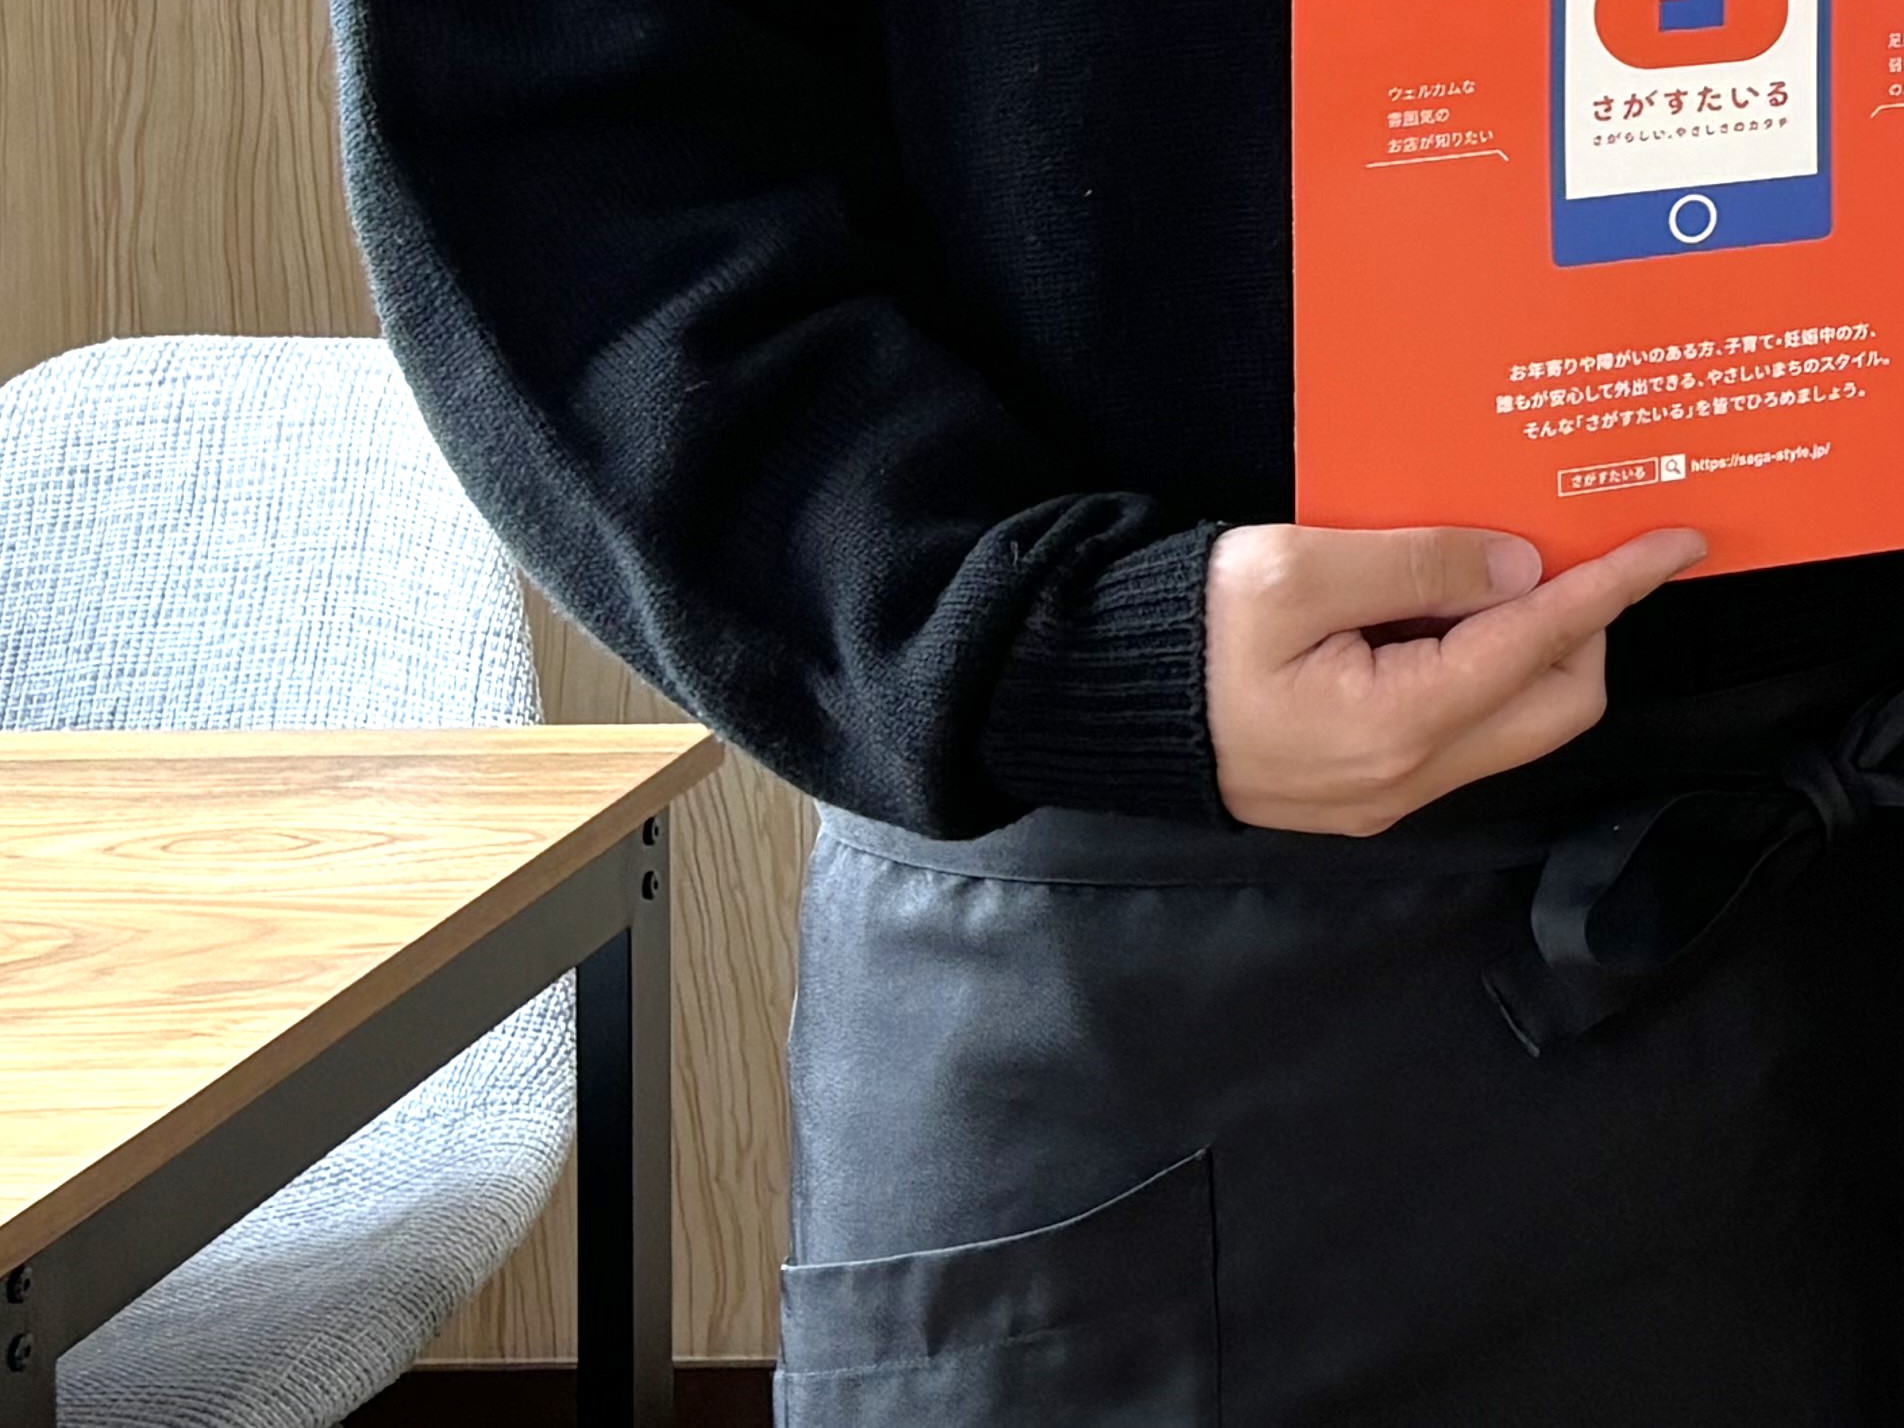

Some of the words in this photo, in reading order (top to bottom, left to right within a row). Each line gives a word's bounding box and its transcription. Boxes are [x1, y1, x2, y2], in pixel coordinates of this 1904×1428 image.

[1388, 80, 1475, 101] ウェルカムな
[1593, 81, 1788, 121] さがすたいる
[1388, 130, 1493, 153] お店が知りたい
[1690, 442, 1831, 474] https://saga-style.jp/
[1570, 466, 1646, 488] さがすたいる
